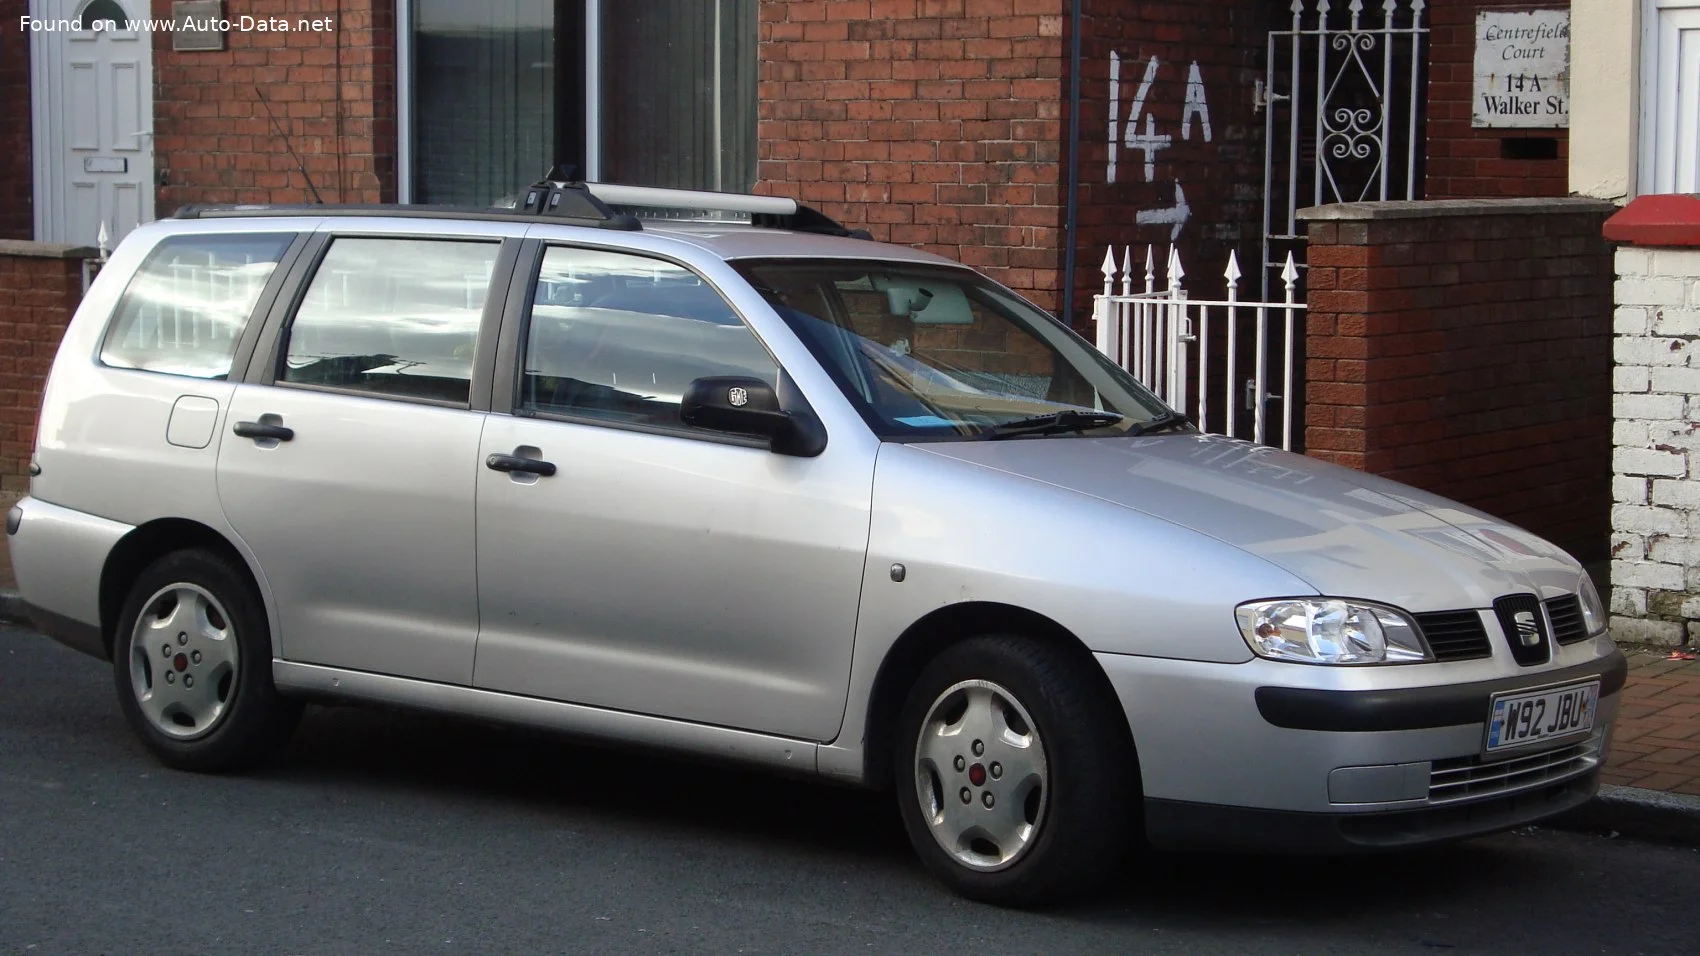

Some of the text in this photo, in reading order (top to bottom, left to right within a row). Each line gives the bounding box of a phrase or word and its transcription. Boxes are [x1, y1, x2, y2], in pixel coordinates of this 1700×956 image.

[1502, 45, 1546, 61] Court
[1484, 96, 1569, 115] Walker St.
[1505, 691, 1584, 741] W92 JBU
